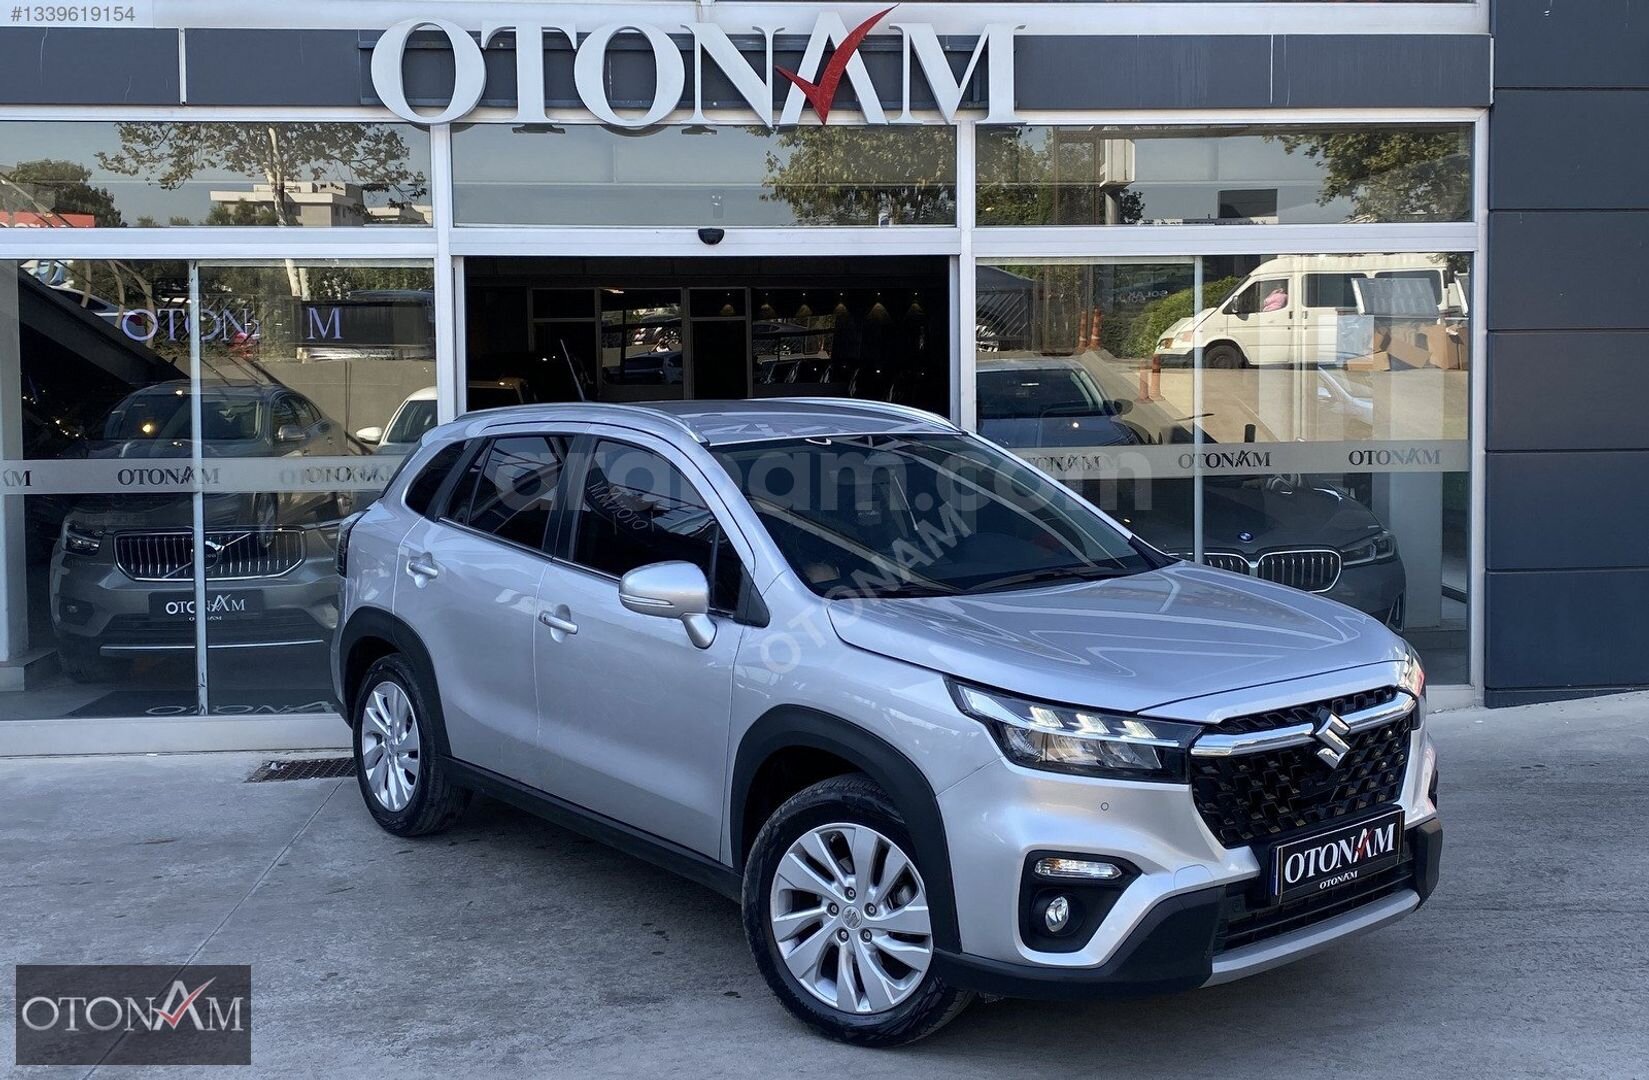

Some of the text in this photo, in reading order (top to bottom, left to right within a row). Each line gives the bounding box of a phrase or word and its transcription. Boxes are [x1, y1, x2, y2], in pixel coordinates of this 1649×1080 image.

[371, 6, 1026, 128] OTONAM
[1178, 450, 1271, 469] OTONAM
[1348, 450, 1441, 467] OTONAM
[117, 465, 221, 486] OTONAM
[1284, 822, 1397, 884] OTONAM
[1319, 870, 1359, 890] OTONAM
